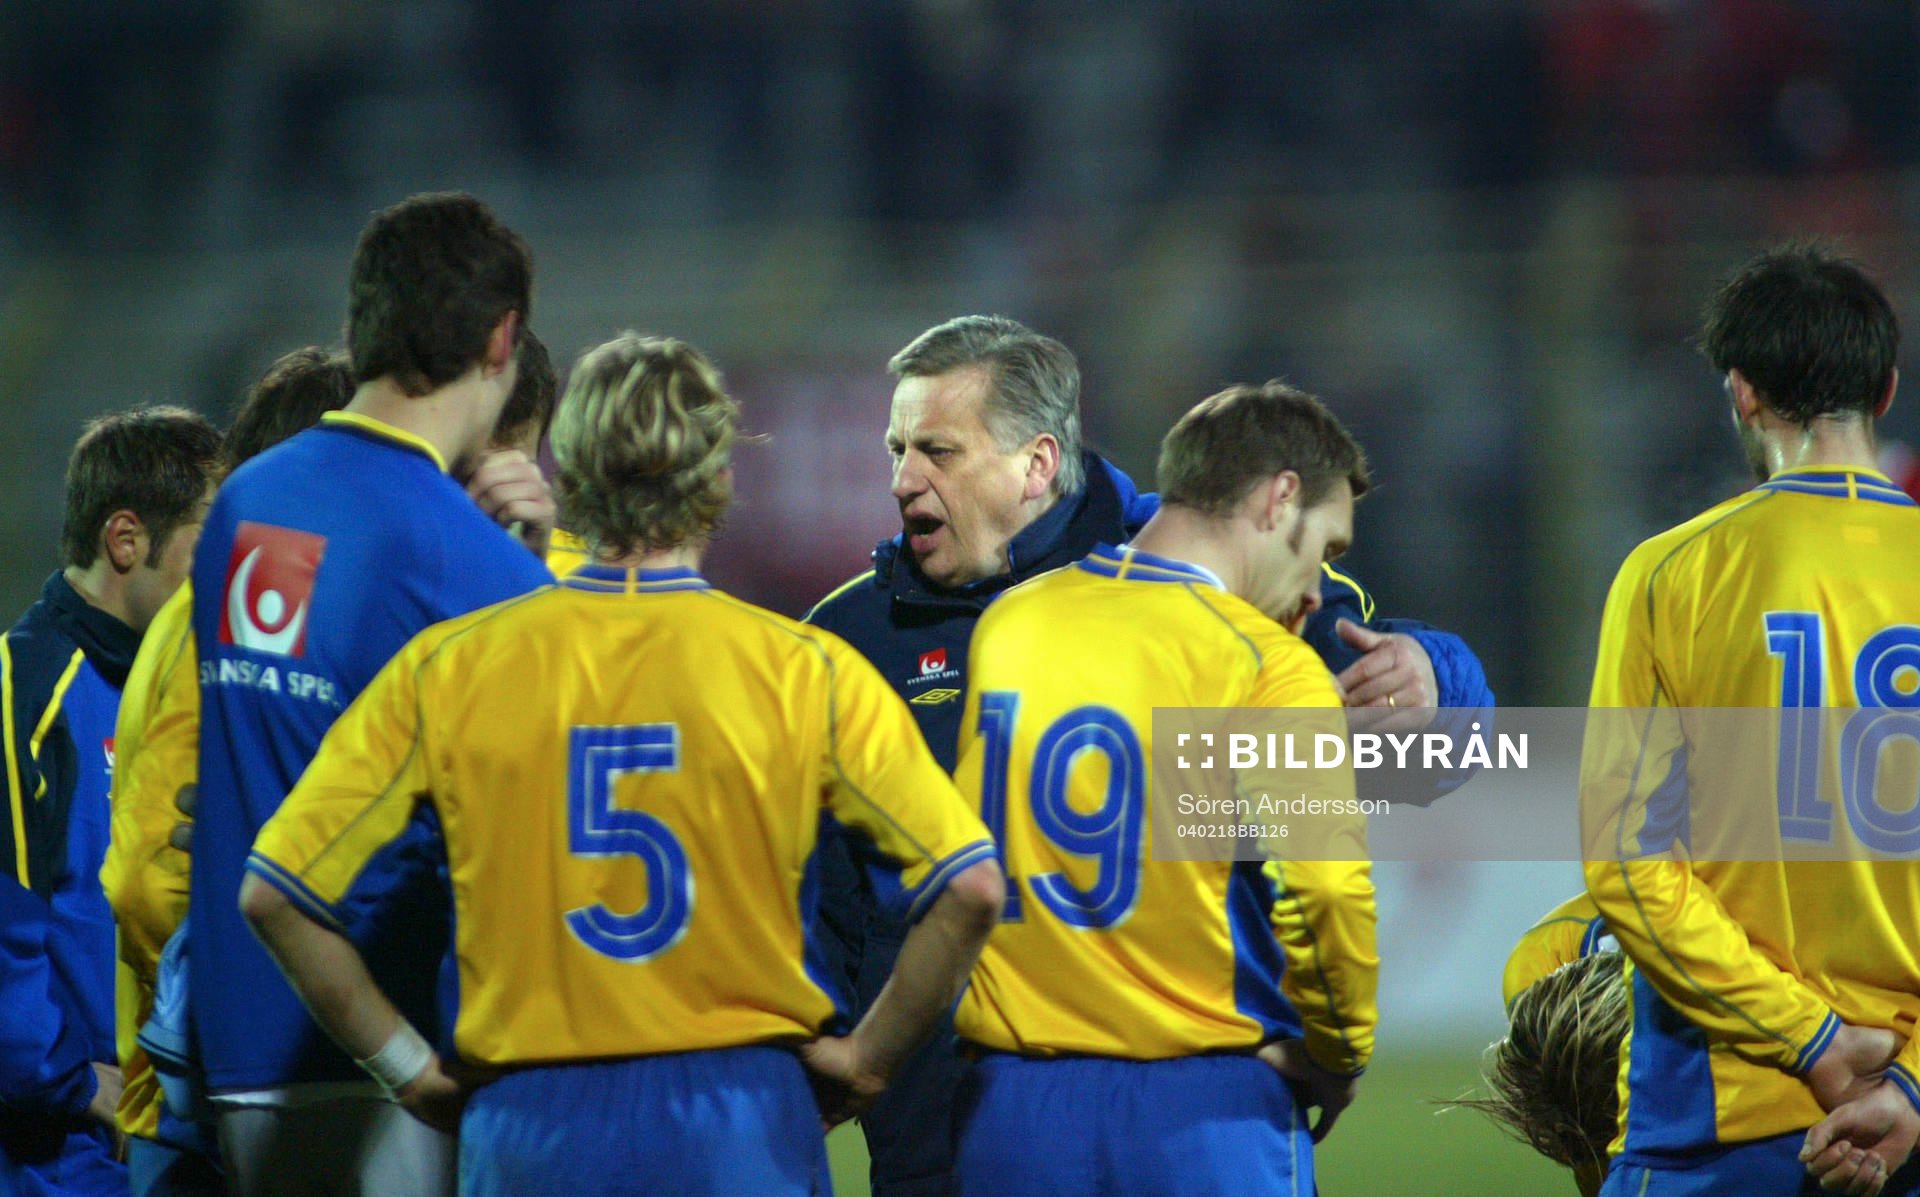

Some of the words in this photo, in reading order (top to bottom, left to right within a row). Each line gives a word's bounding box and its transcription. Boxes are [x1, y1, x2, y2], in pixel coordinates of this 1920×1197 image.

[286, 670, 342, 711] SPE
[1763, 611, 1920, 855] 18
[565, 723, 696, 963] 5
[976, 691, 1146, 930] 19
